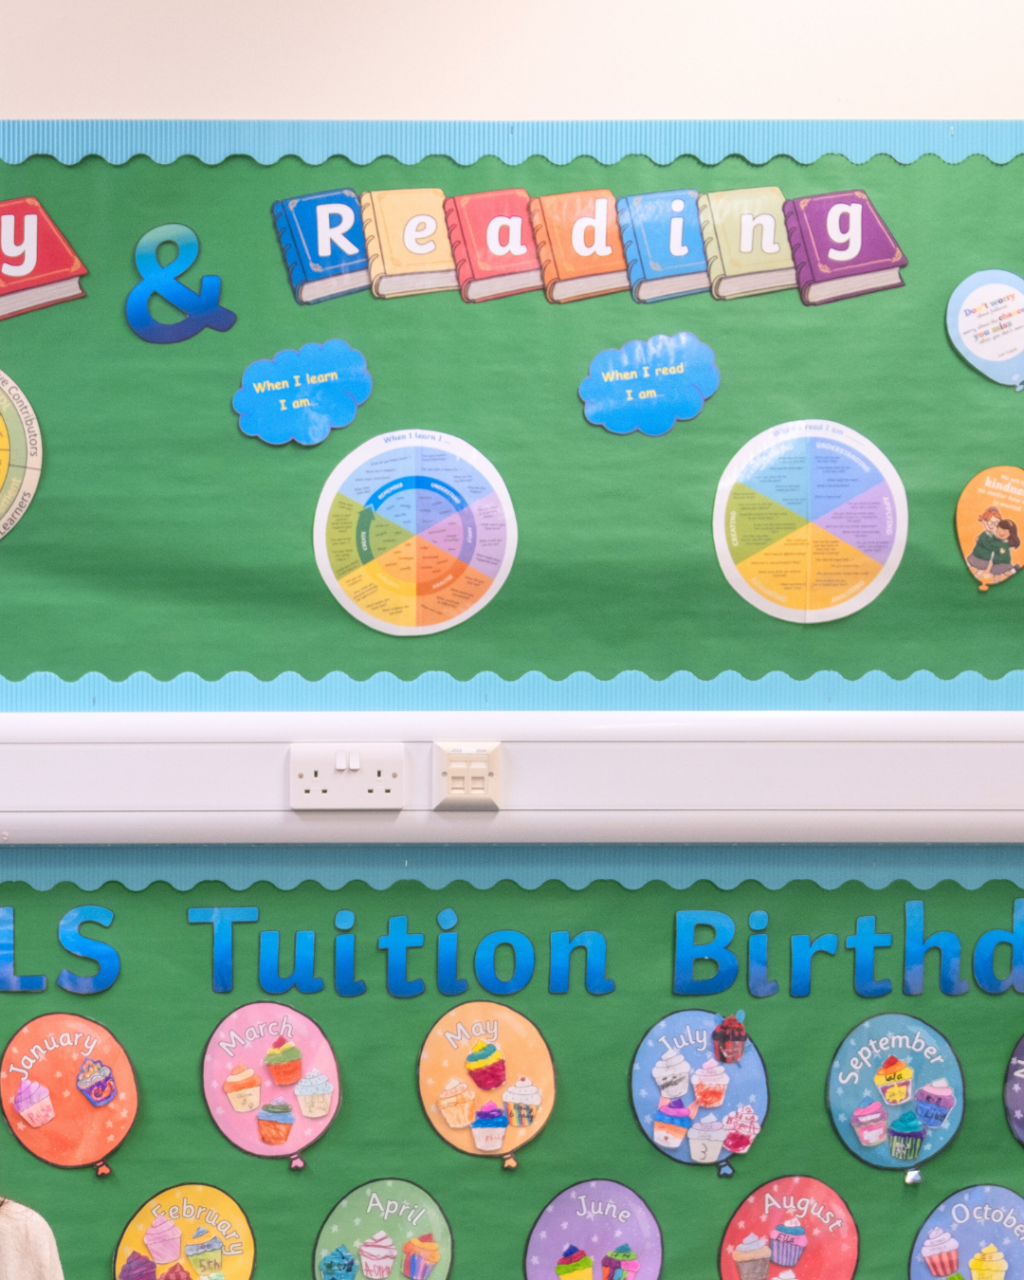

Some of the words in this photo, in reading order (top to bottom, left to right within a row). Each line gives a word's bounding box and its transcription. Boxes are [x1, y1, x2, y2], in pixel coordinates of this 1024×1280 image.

[125, 222, 237, 344] &
[316, 198, 863, 262] Reading
[253, 380, 289, 393] When
[293, 375, 301, 386] I
[306, 371, 338, 384] learn
[601, 370, 638, 382] When
[643, 366, 650, 378] I
[655, 362, 684, 375] read
[279, 400, 287, 410] I
[626, 390, 633, 400] I
[8, 386, 38, 457] Contributors
[383, 432, 406, 444] When
[415, 432, 436, 441] learn
[816, 442, 871, 473] UNDERSTANDING
[431, 482, 460, 504] UNDERSTAND
[985, 476, 1024, 495] kindne
[188, 906, 615, 998] Tuition
[218, 1016, 294, 1058] March
[444, 1020, 499, 1049] May
[658, 1025, 707, 1051] July
[8, 1029, 98, 1080] January
[838, 1030, 945, 1085] September
[367, 1193, 426, 1226] April
[576, 1195, 631, 1222] June
[764, 1193, 843, 1232] August
[951, 1202, 1024, 1240] Octobe
[151, 1197, 244, 1256] February
[777, 1234, 795, 1243] Ella
